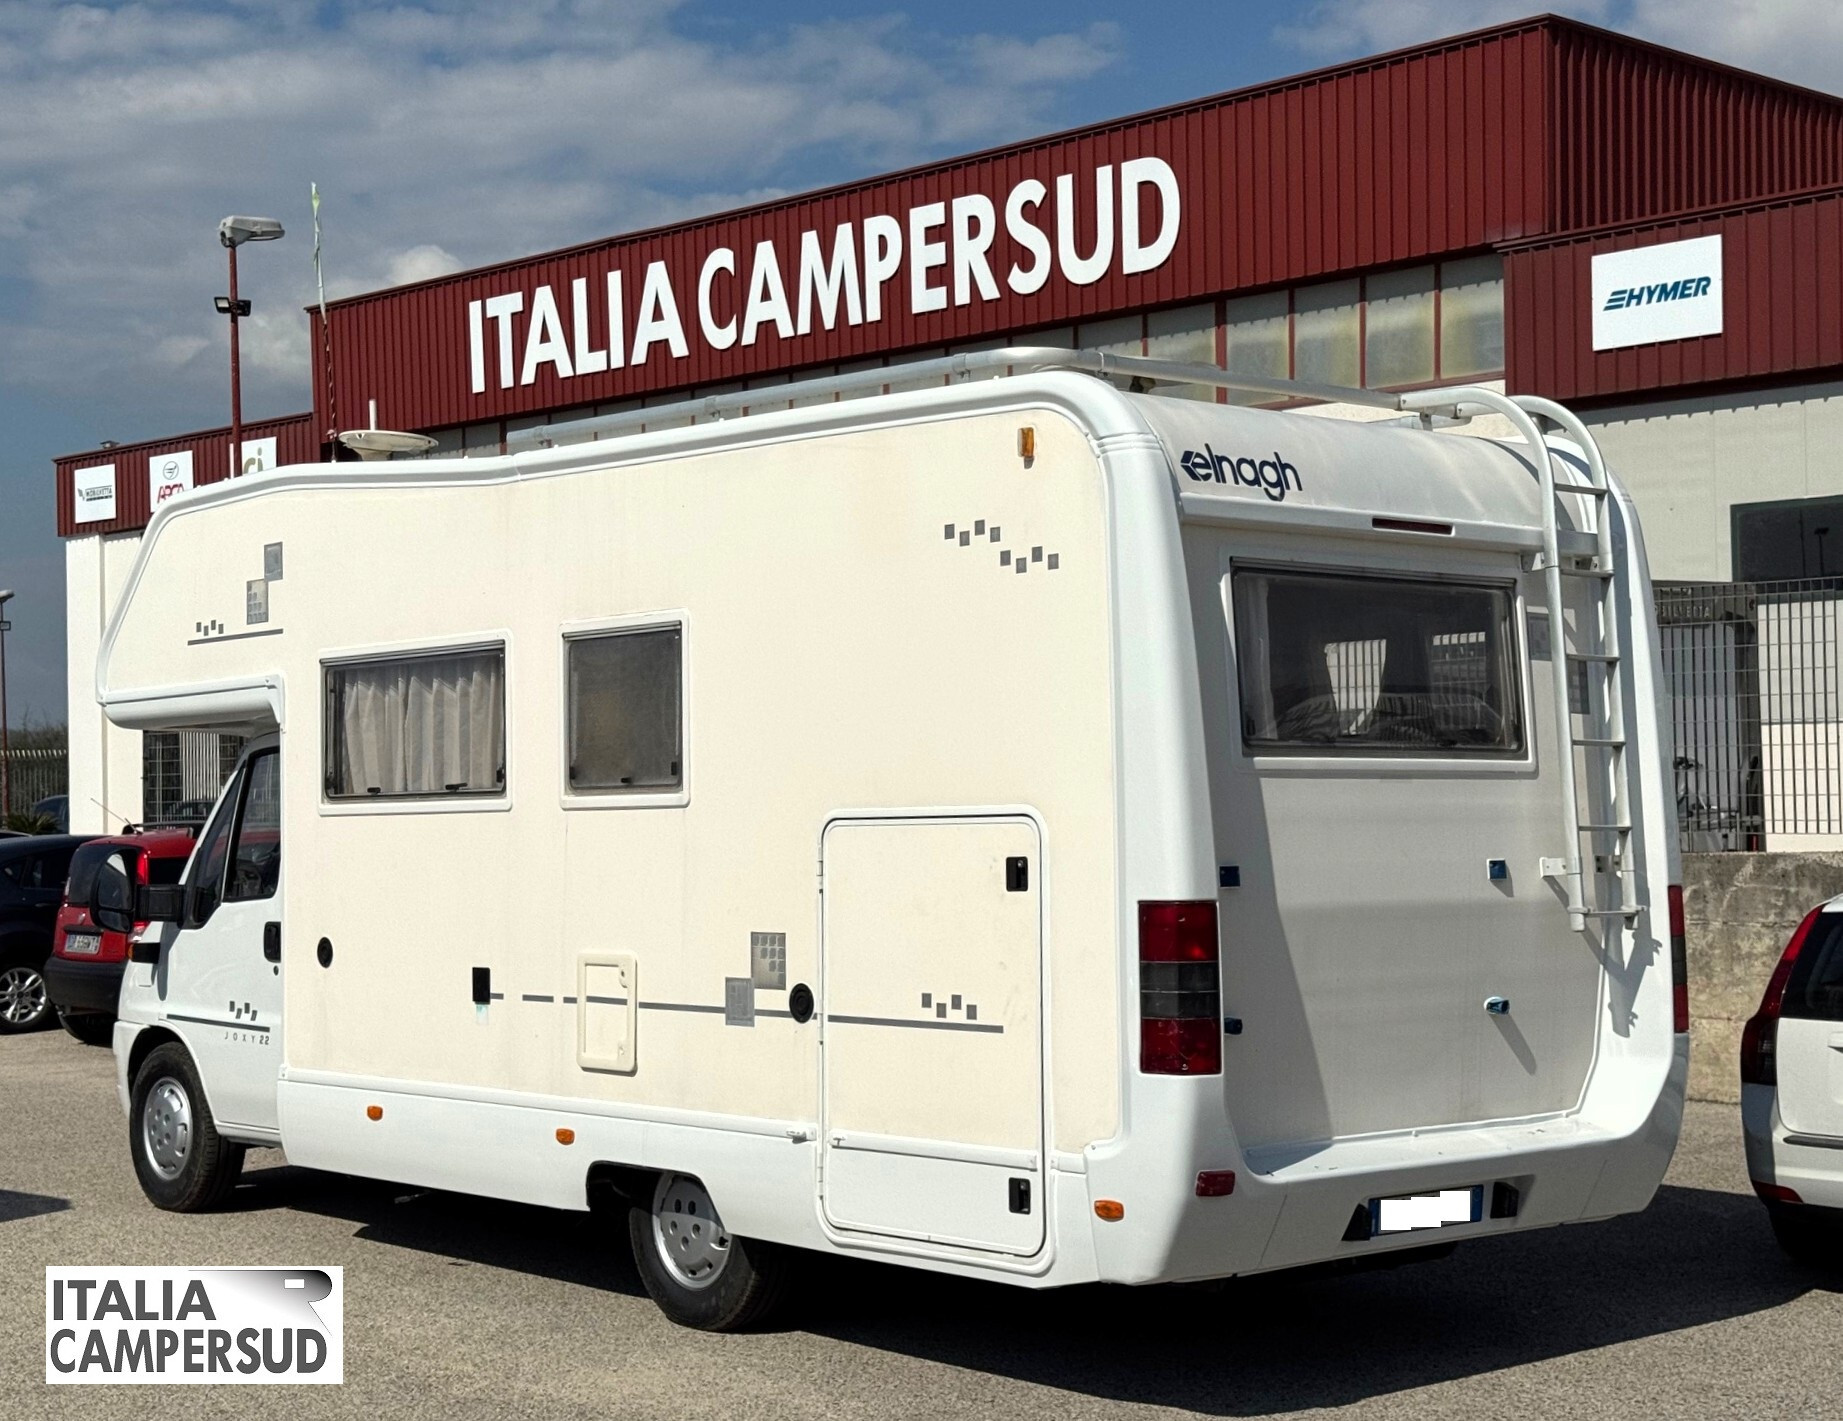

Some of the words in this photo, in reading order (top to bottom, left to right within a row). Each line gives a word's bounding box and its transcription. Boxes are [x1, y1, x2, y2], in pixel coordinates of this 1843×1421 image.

[468, 259, 690, 394] ITALIA
[697, 156, 1181, 351] CAMPERSUD
[1624, 276, 1712, 309] HYMER
[1189, 442, 1304, 503] elnagh
[224, 1031, 256, 1044] JOXY
[259, 1034, 270, 1046] 22
